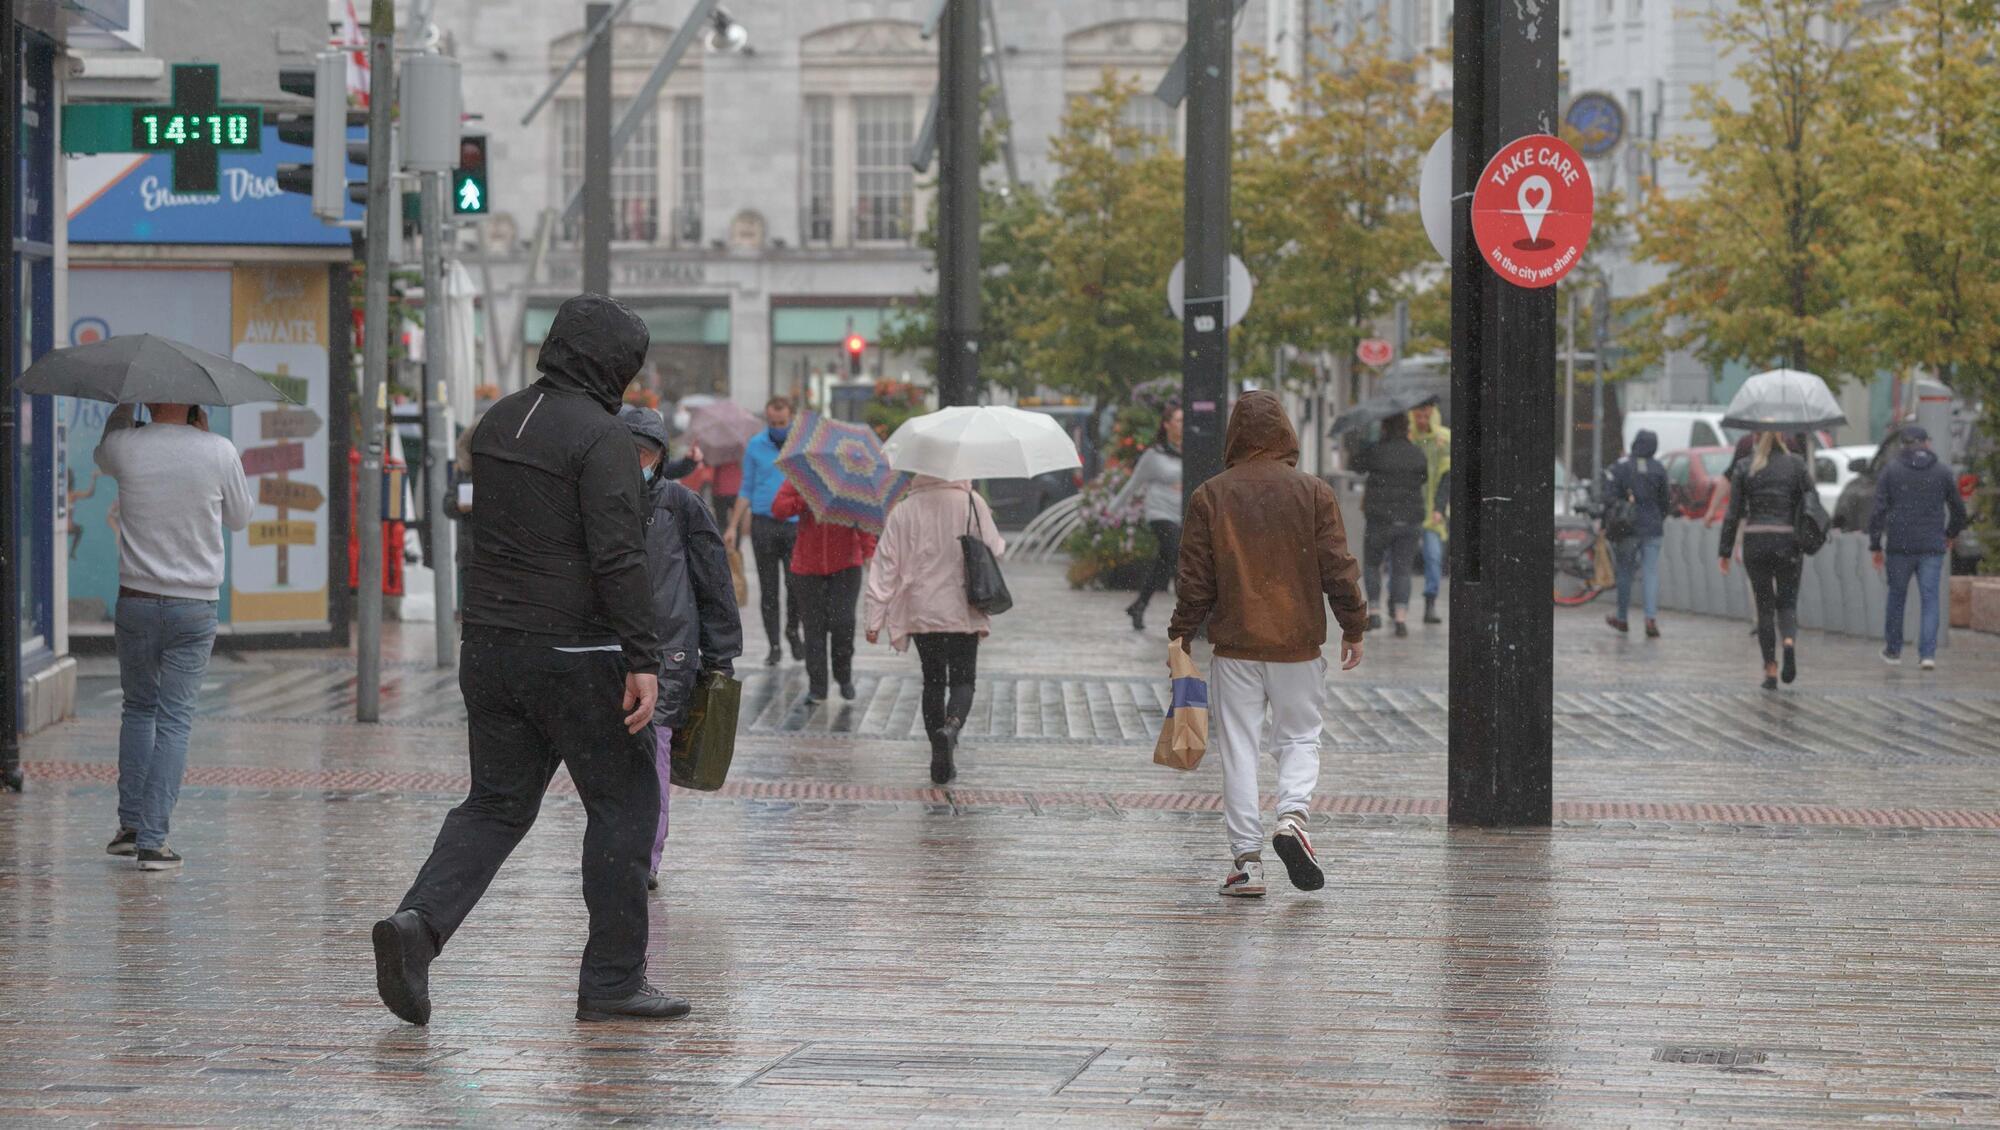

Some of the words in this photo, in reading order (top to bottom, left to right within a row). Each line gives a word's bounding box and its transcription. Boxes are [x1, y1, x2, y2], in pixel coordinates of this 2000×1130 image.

[142, 115, 248, 144] 14:10
[1491, 147, 1535, 186] TAKE
[1538, 147, 1579, 187] CARE
[1491, 246, 1503, 261] in
[1502, 257, 1518, 275] the
[1518, 266, 1538, 283] city
[1538, 266, 1554, 279] we
[1553, 245, 1577, 272] share
[244, 319, 317, 344] AWAITS
